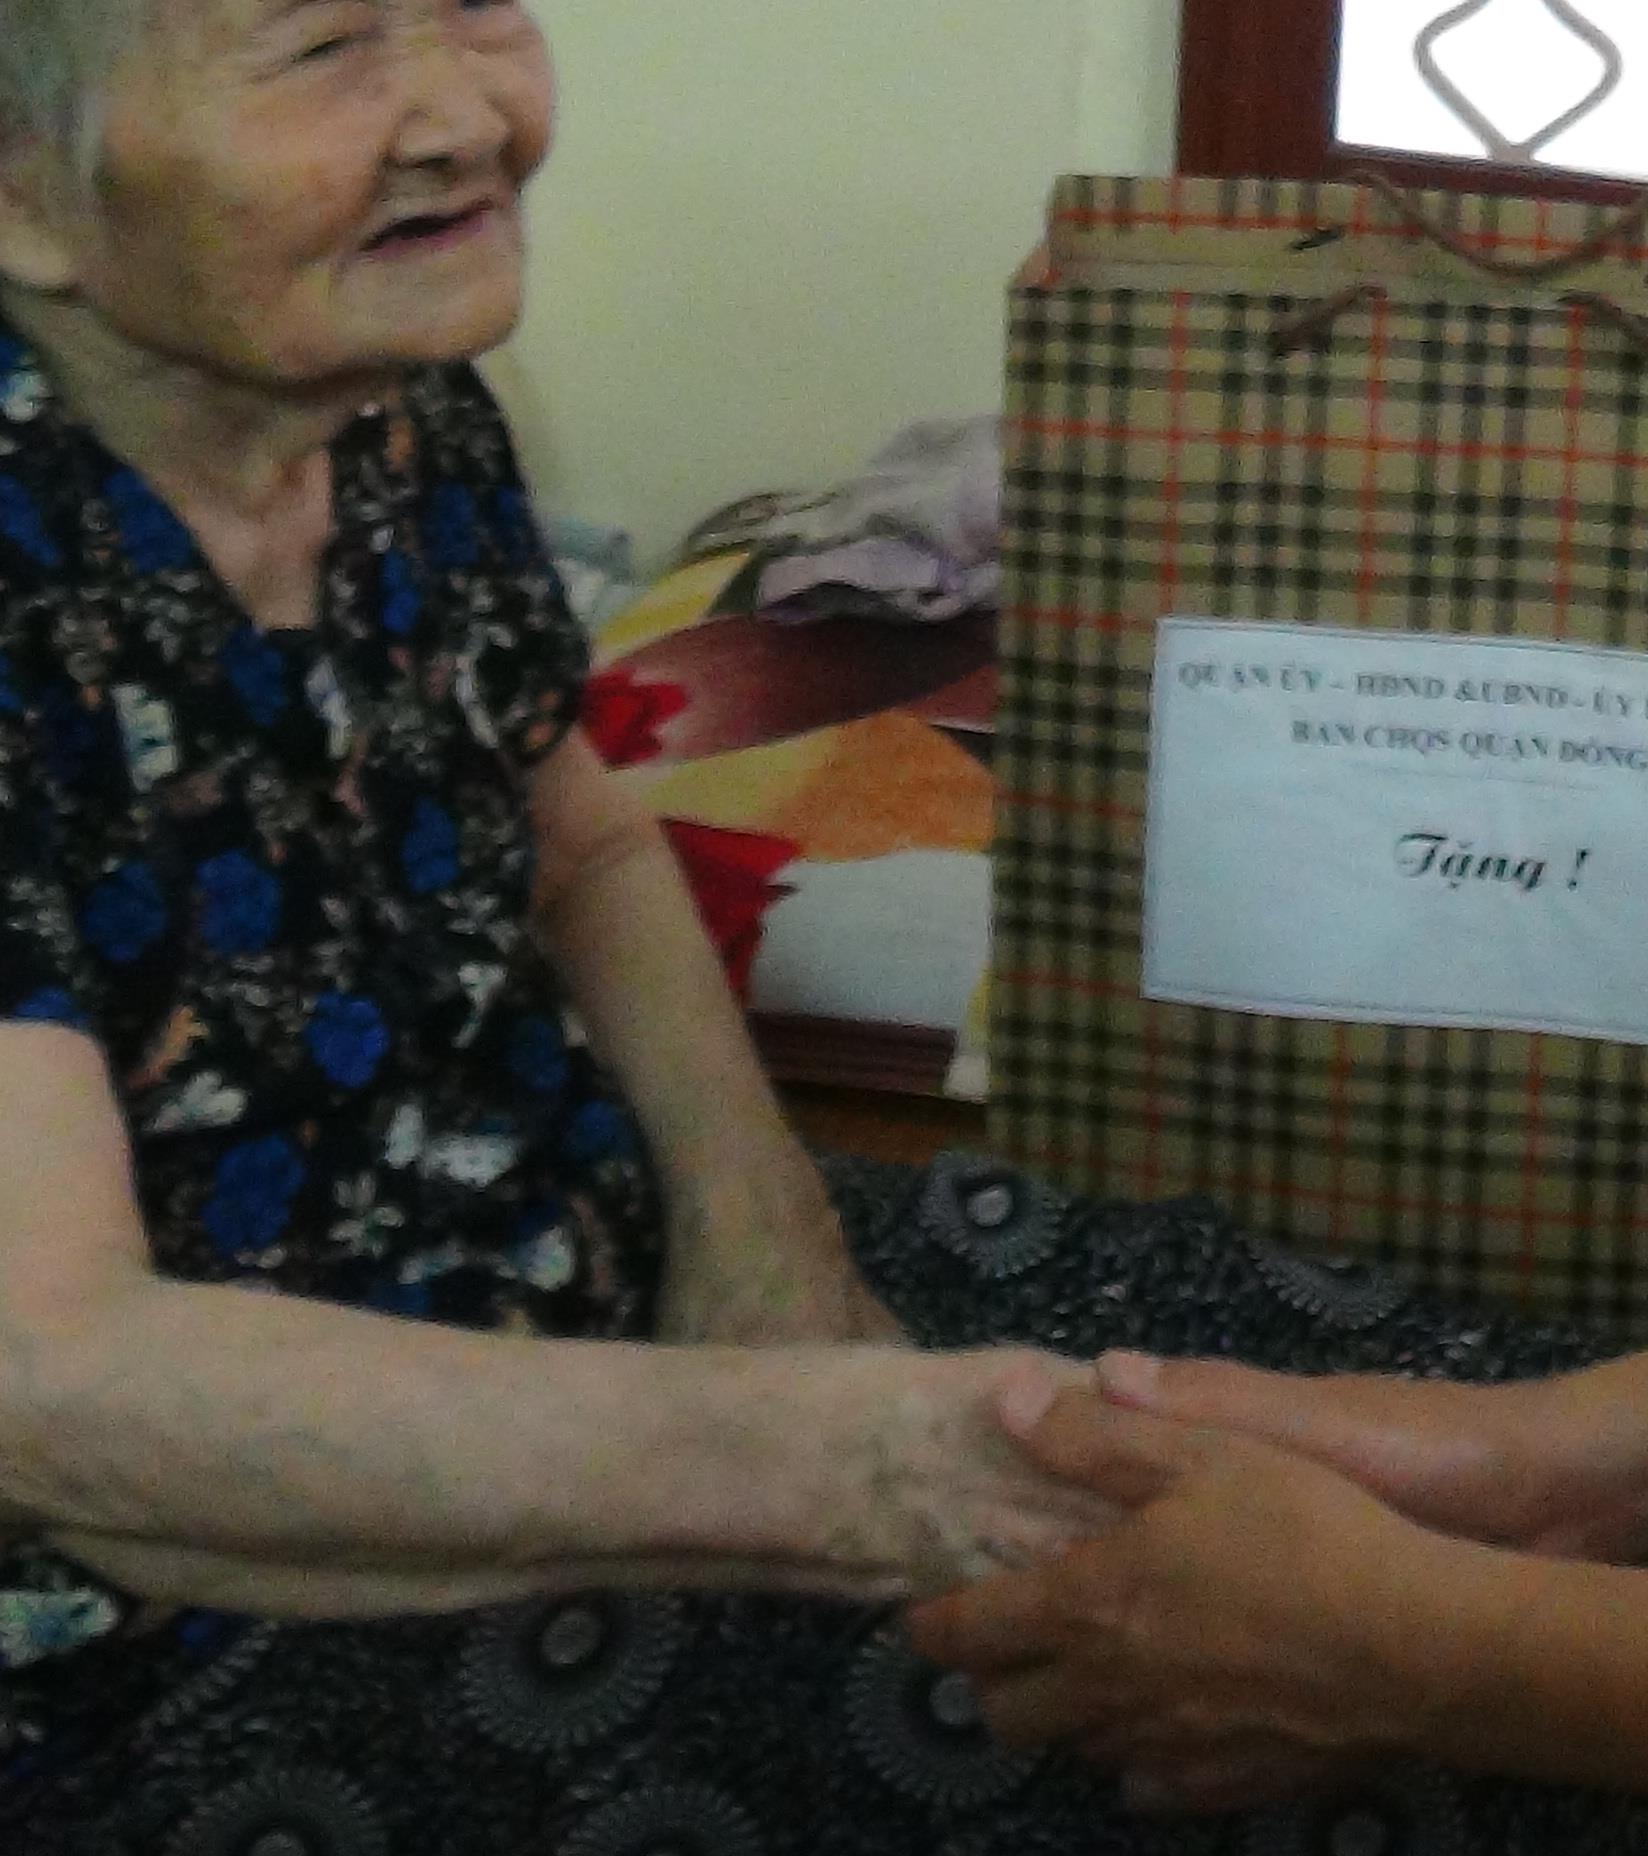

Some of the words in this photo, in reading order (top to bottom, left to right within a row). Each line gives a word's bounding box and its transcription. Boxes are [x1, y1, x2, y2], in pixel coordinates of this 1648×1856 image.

[1290, 718, 1356, 746] BAN
[1393, 832, 1548, 892] Tặng
[1566, 847, 1591, 892] !
